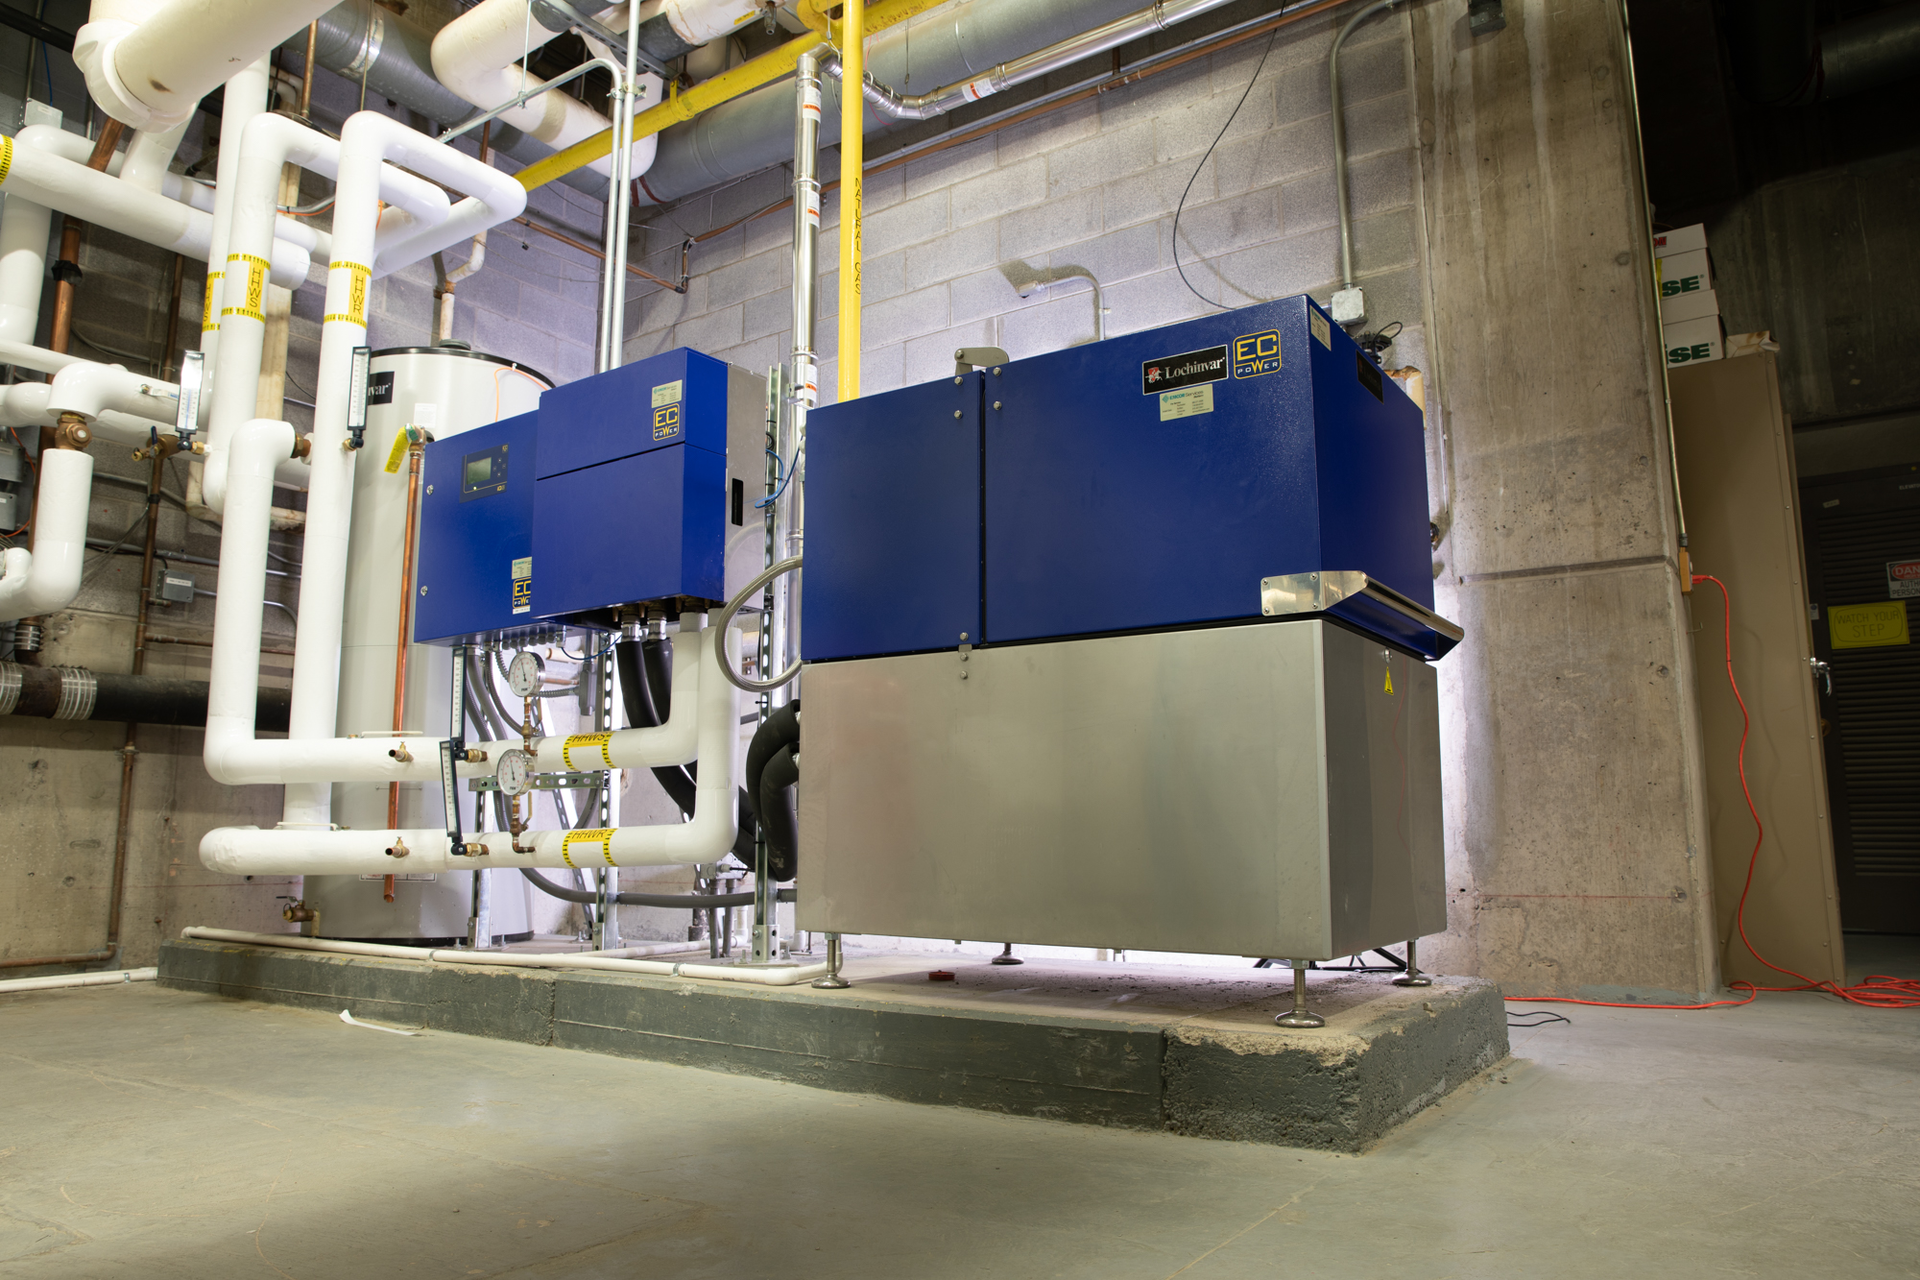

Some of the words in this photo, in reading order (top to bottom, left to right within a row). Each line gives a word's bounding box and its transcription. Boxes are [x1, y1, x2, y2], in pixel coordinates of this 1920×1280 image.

[249, 267, 261, 308] HHWS
[352, 275, 364, 315] HHWR
[1236, 334, 1278, 361] EC
[1165, 358, 1224, 379] Lochinvar
[1237, 359, 1278, 375] POWER
[656, 407, 678, 427] EC
[1835, 613, 1869, 624] WATCH
[1874, 610, 1899, 621] YOUR
[1852, 623, 1885, 638] STEP
